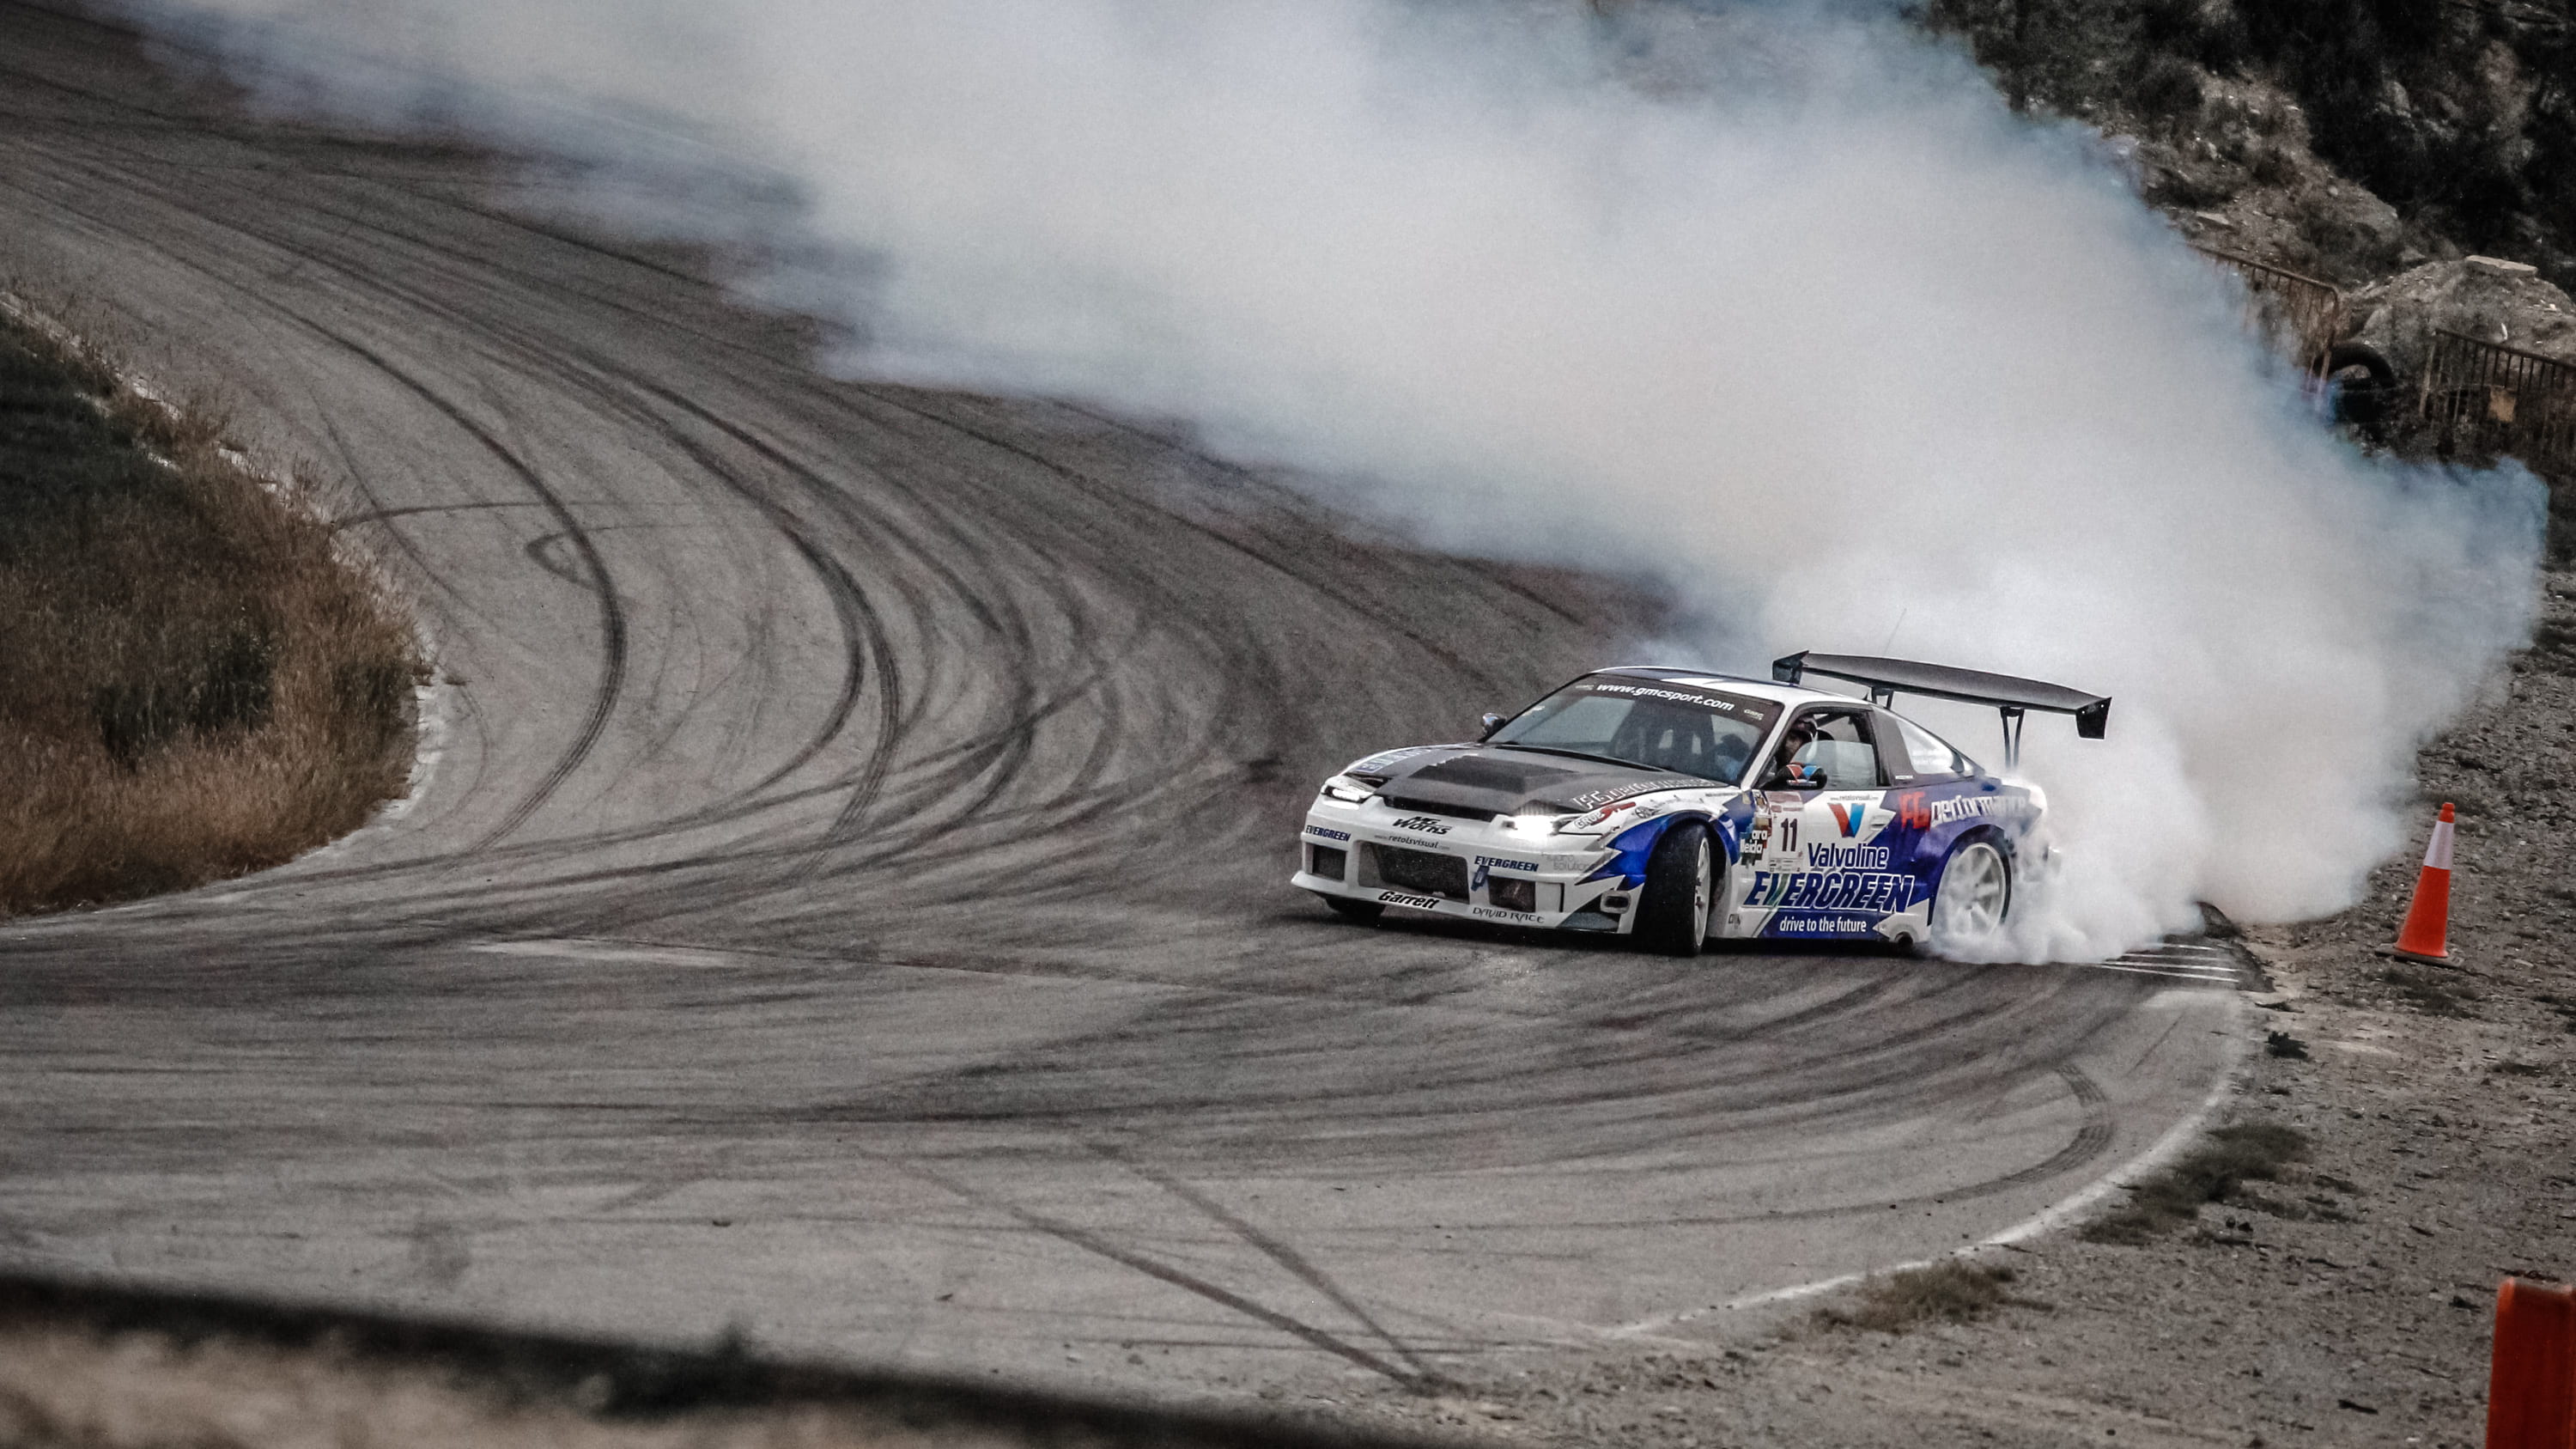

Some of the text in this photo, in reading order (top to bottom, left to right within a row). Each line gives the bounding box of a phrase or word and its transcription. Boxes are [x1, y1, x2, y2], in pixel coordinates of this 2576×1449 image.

[1596, 684, 1735, 711] www.gmcsport.com
[1305, 825, 1352, 842] EVERGREEN
[1781, 818, 1797, 852] 11
[1474, 855, 1539, 872] EVERGREEN
[1807, 843, 1889, 868] Valvoline
[1378, 891, 1440, 910] Garrett
[1741, 871, 1915, 913] EVERGREEN
[1473, 907, 1545, 923] DAVID RACE
[1780, 916, 1867, 932] drive to the future
